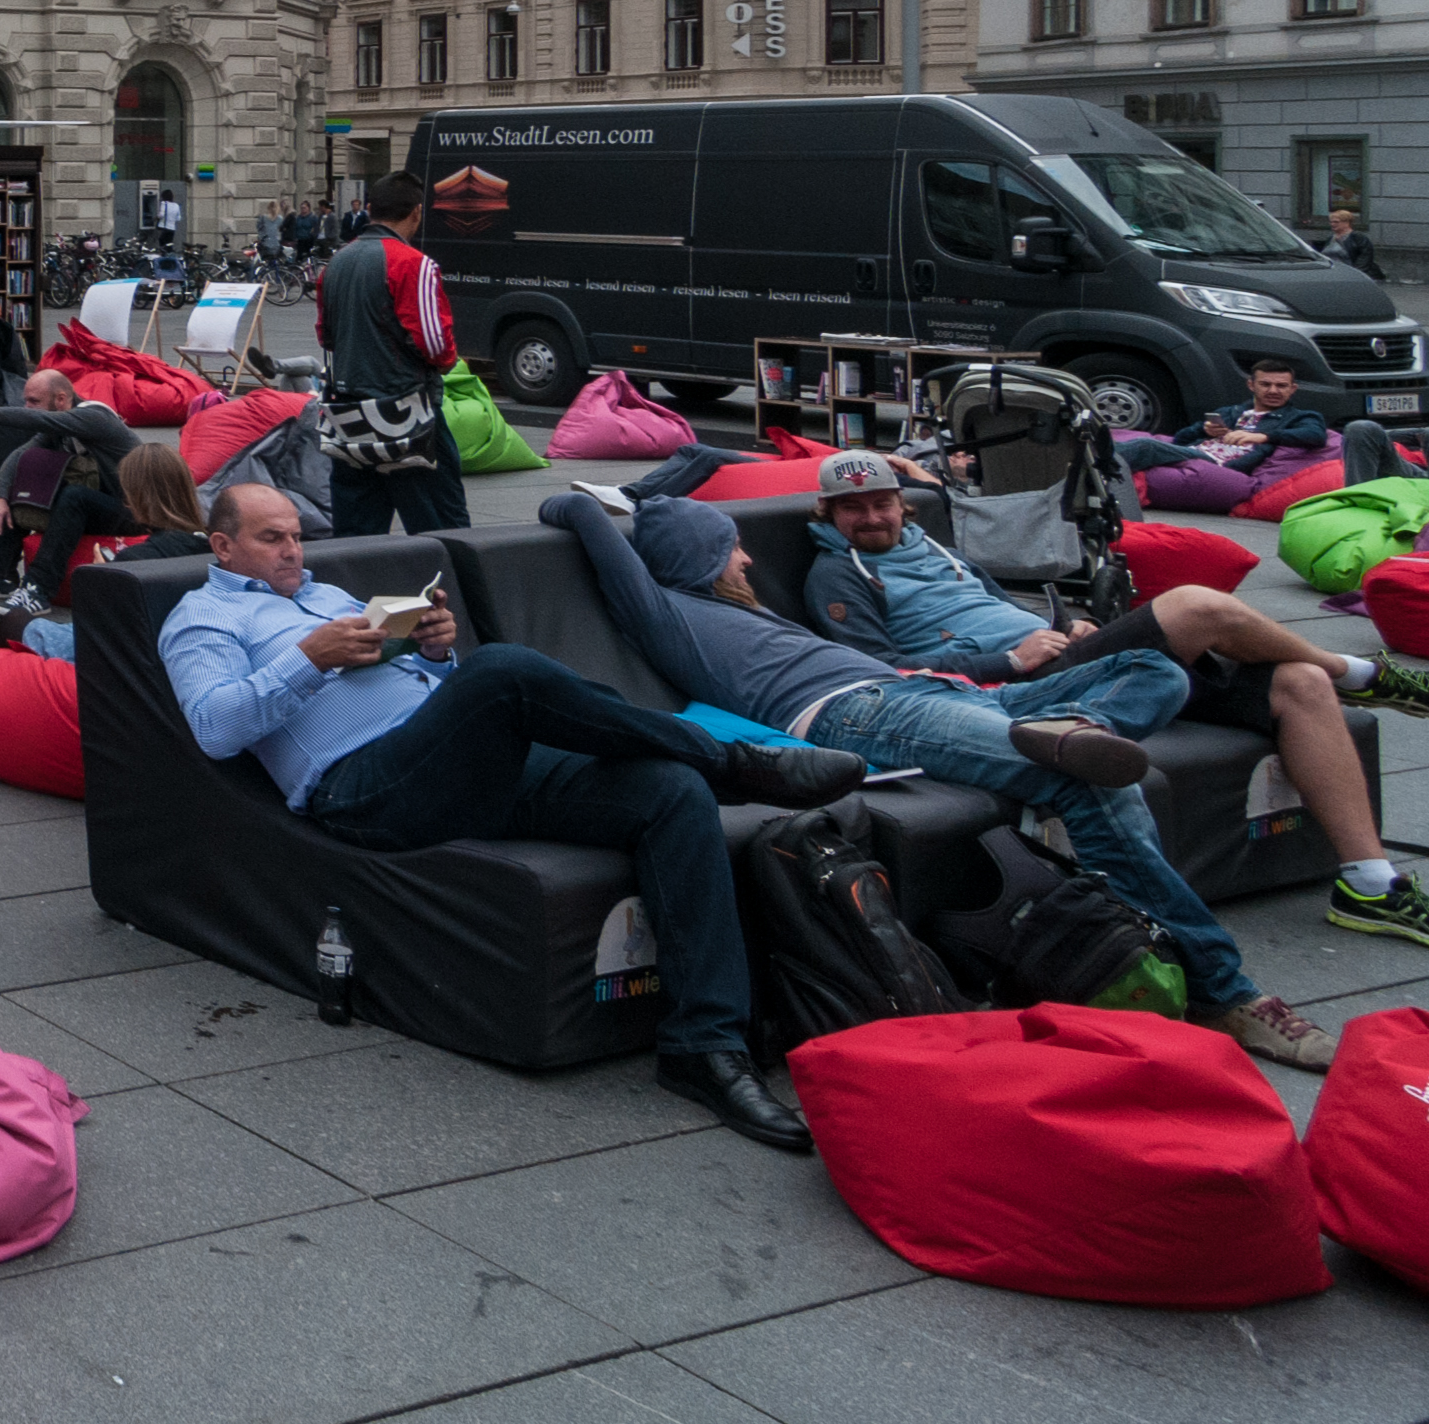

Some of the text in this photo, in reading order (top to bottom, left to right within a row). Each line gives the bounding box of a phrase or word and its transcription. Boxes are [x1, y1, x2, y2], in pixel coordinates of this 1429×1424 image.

[438, 126, 654, 147] www.StadtLesen.com
[462, 273, 490, 283] reisen
[505, 275, 540, 287] reisend
[543, 276, 569, 288] lesen
[585, 278, 619, 291] lesend
[622, 280, 655, 293] reisen
[673, 283, 714, 297] reisend
[717, 285, 748, 298] lesen
[768, 288, 800, 302] lesen
[804, 290, 851, 304] reisend
[922, 296, 1005, 308] artistic design
[834, 461, 878, 481] BULLS
[594, 972, 660, 1003] filii.wie
